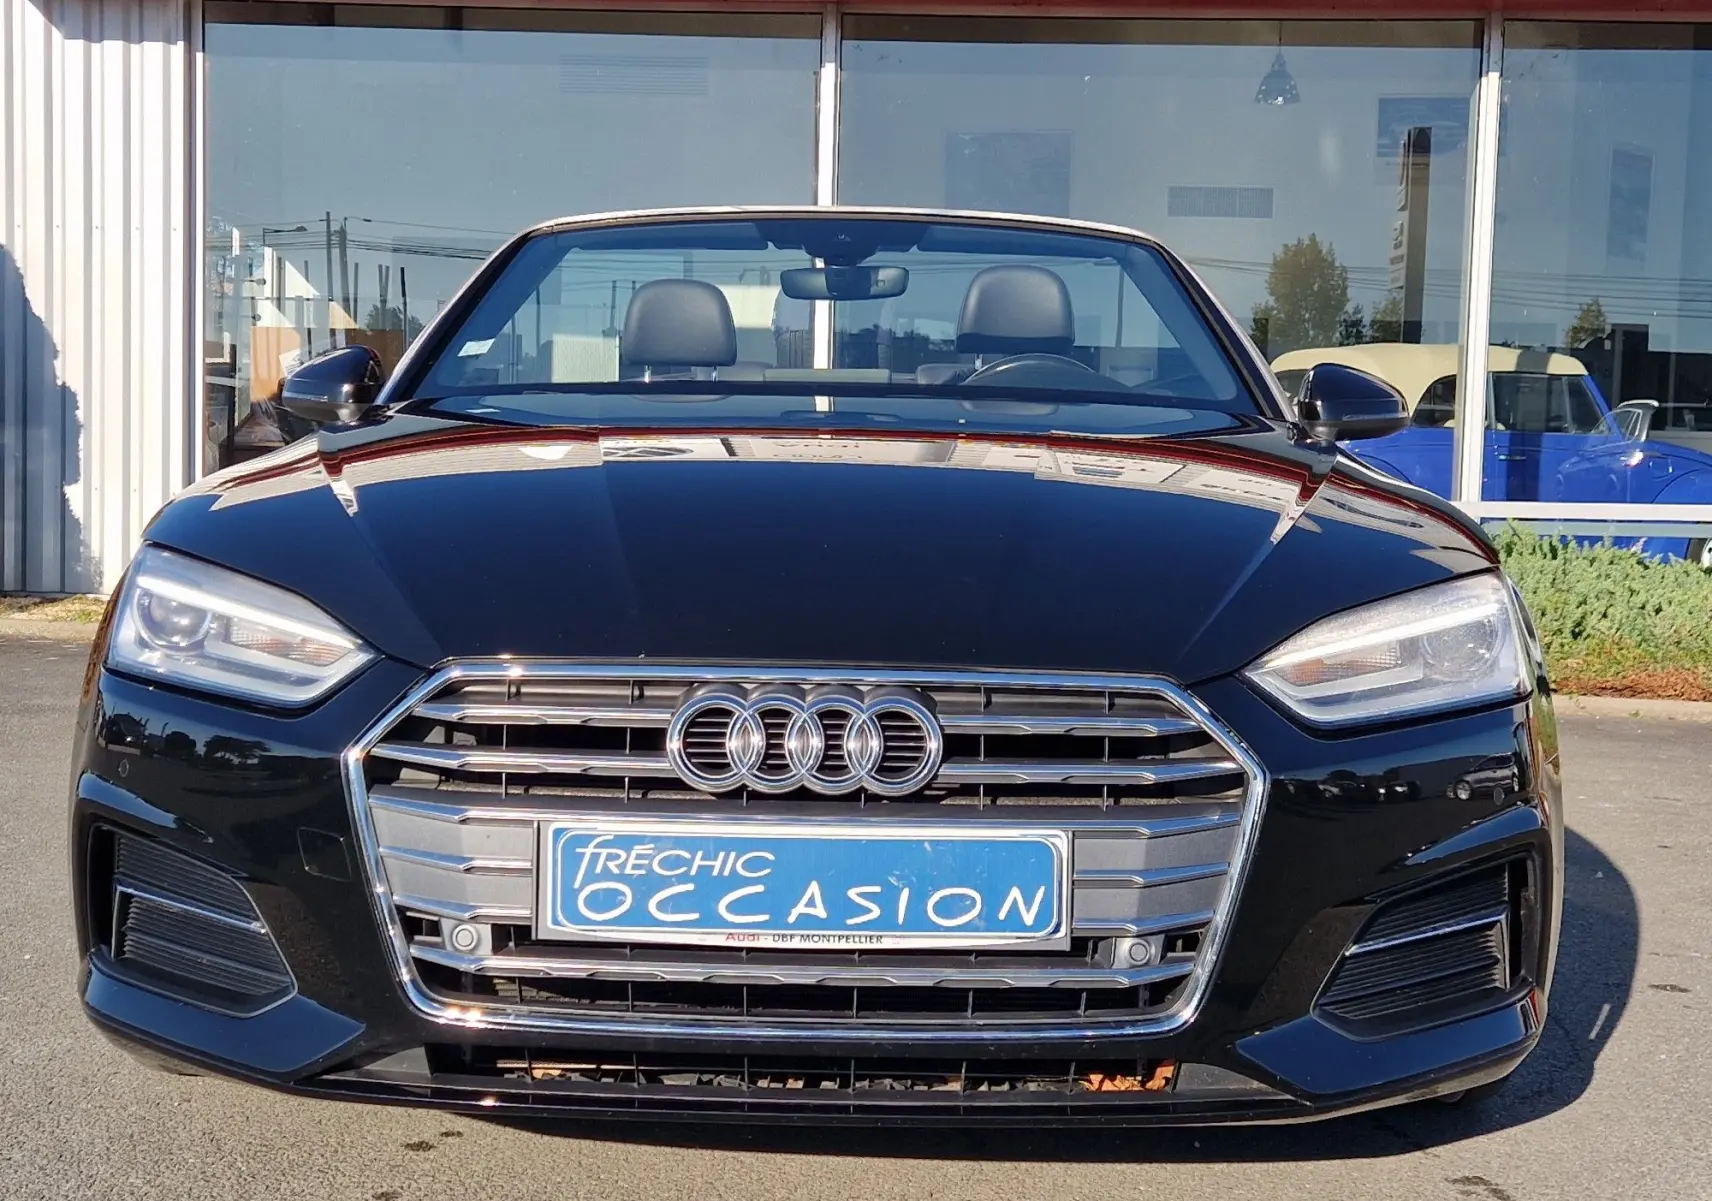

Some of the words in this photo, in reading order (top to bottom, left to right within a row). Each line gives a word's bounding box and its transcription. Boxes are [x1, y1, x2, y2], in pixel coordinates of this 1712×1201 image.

[576, 879, 1047, 928] OCCASION
[725, 931, 760, 942] Audi
[772, 932, 796, 943] DBF
[799, 933, 884, 945] MONTPELLIER
